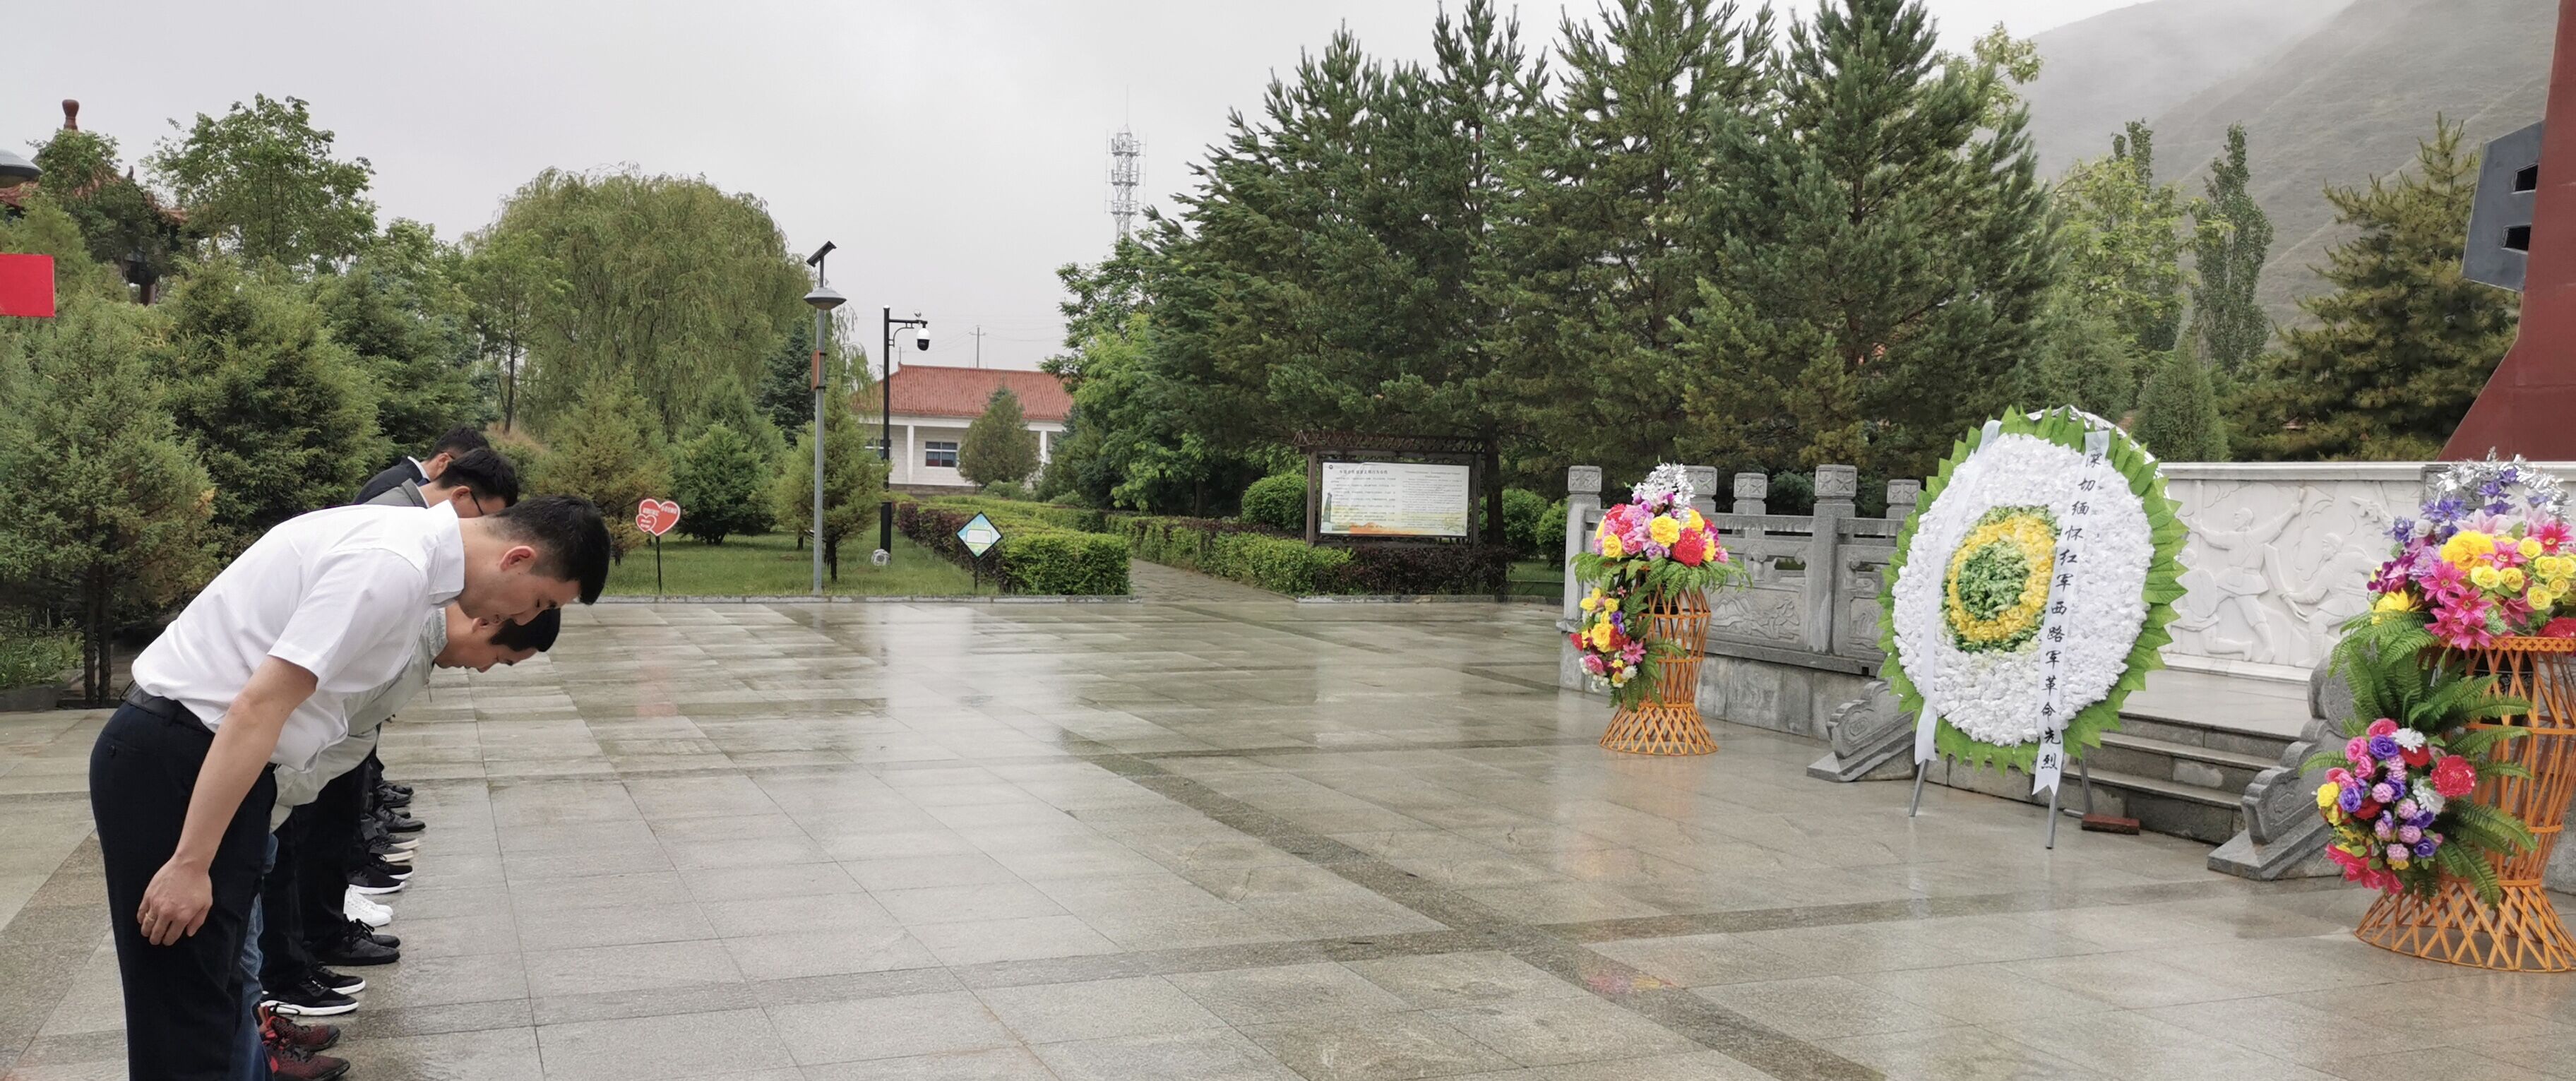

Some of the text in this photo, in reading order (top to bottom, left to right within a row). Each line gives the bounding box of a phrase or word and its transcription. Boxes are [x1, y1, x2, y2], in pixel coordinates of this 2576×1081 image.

[2041, 452, 2102, 771] 深切缅怀红军西路军革命先烈
